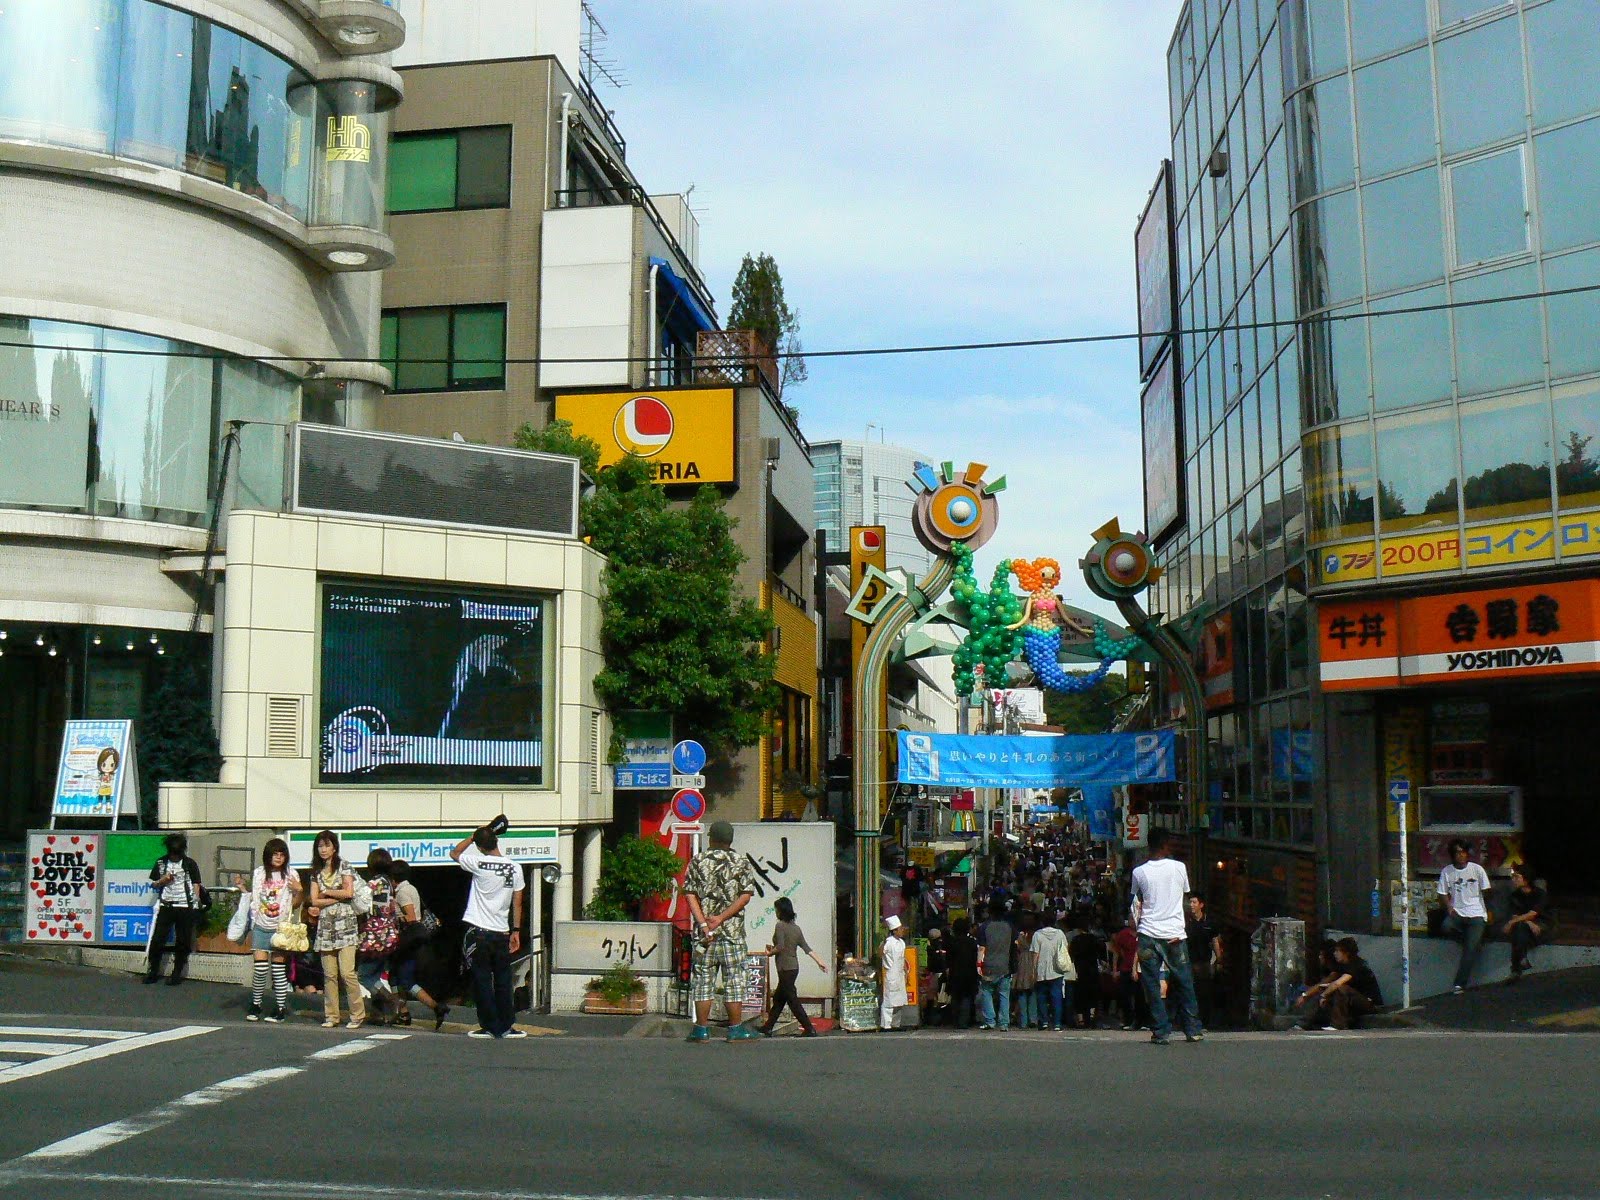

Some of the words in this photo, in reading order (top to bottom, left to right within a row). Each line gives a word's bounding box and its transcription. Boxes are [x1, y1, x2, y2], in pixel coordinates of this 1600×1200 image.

[334, 148, 368, 161] アッシュ
[1467, 521, 1600, 556] コインロ
[1327, 612, 1387, 650] 牛丼
[1447, 645, 1564, 672] YOSHINOYA
[617, 772, 634, 787] 酒
[637, 773, 668, 785] たばこ
[505, 846, 551, 855] 原宿竹下口店
[42, 852, 88, 867] GIRL
[33, 866, 95, 882] LOVES
[45, 881, 85, 897] BOY
[108, 919, 128, 937] 酒
